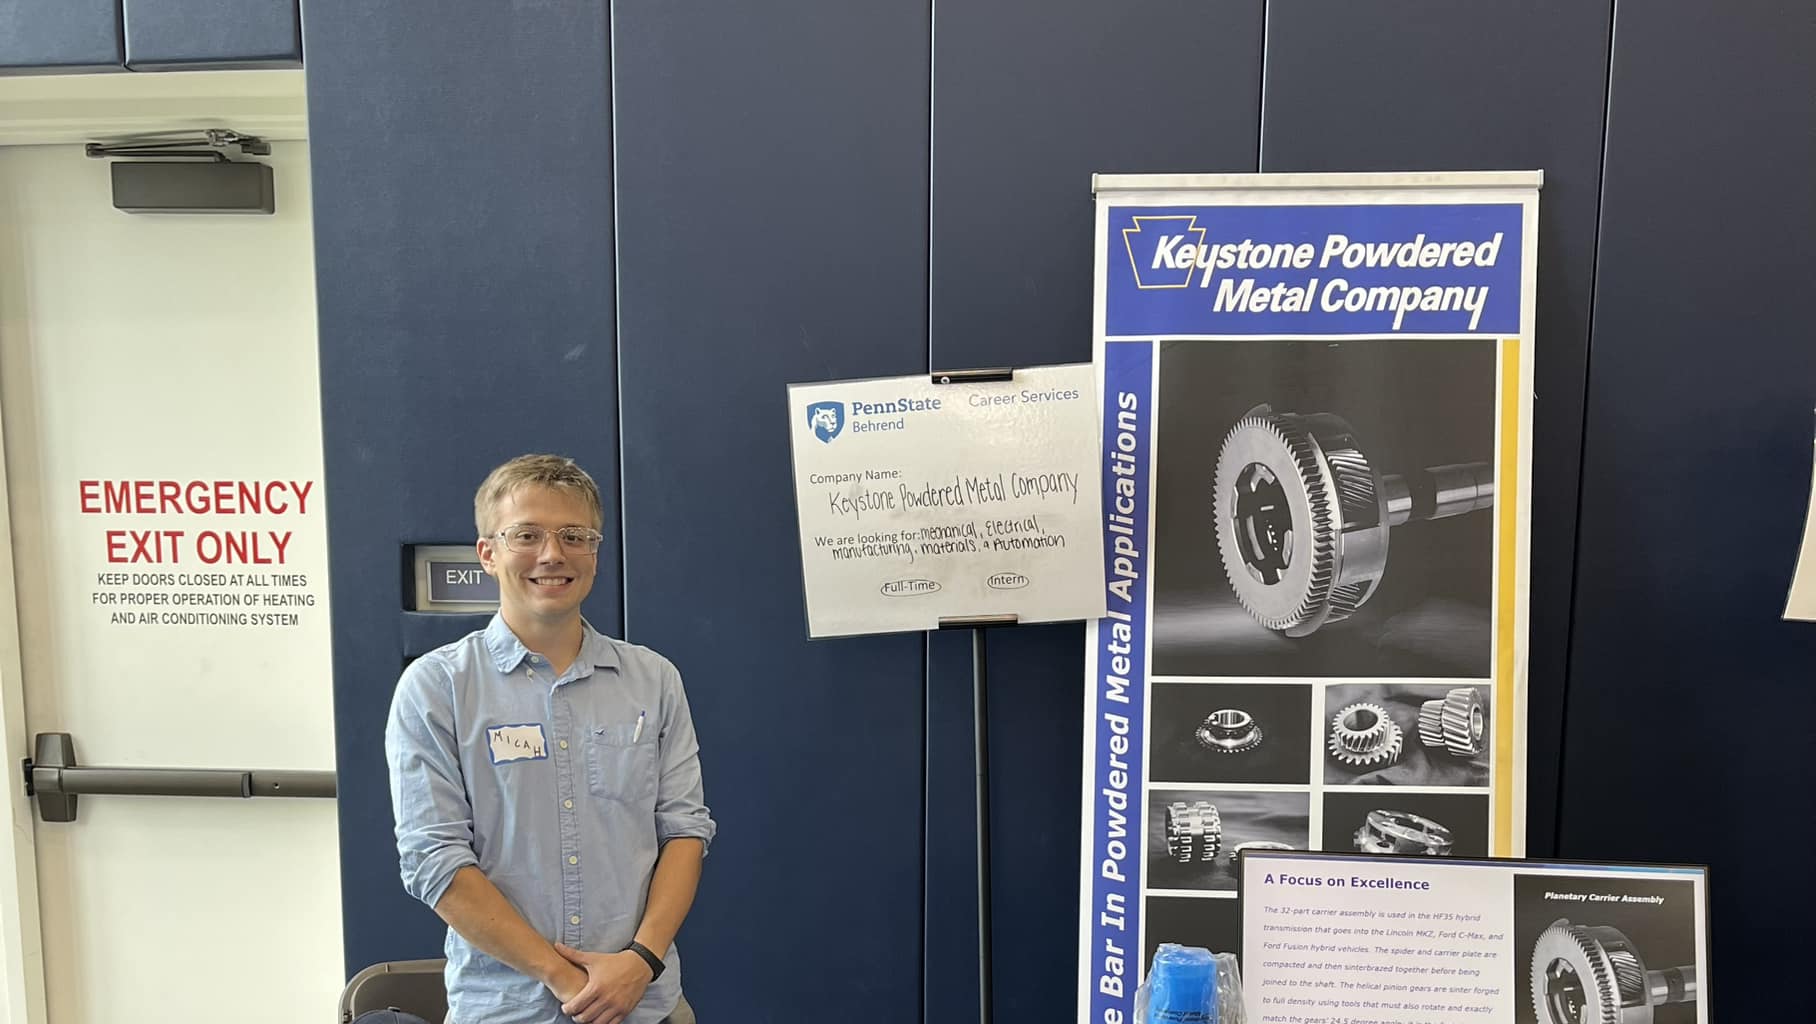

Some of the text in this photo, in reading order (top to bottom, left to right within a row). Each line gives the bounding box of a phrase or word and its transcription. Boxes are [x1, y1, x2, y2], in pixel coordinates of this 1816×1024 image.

[1151, 233, 1504, 288] Keystone Powdered
[1212, 278, 1489, 331] Metal Company
[851, 397, 942, 416] PennState
[968, 388, 1080, 408] Career Services
[852, 418, 905, 433] Behrend
[809, 469, 903, 485] Company Name:
[80, 480, 314, 515] EMERGENCY
[829, 471, 1079, 520] Keystone Powdered Metal Company
[1107, 391, 1139, 603] Applications
[106, 530, 292, 564] EXIT ONLY
[814, 530, 921, 547] We are looking for:
[98, 573, 307, 587] KEEP DOORS CLOSED AT ALL TIMES
[446, 569, 484, 585] EXIT
[884, 575, 1025, 593] Full-Time Intern
[92, 592, 315, 607] FOR PROPER OPERATION OF HEATING
[111, 612, 299, 626] AND AIR CONDITIONING SYSTEM
[1104, 610, 1132, 704] Metal
[493, 731, 542, 758] MICAH
[1100, 711, 1130, 883] Powdered
[1264, 873, 1430, 890] A Focus on Excellence
[1544, 891, 1664, 905] Planetary Carrier Assembly
[1101, 892, 1126, 932] In
[1264, 906, 1278, 914] The
[1339, 910, 1376, 919] assembly
[1387, 911, 1406, 919] used
[1455, 914, 1481, 923] hybrid
[1263, 925, 1312, 933] transmission
[1315, 926, 1331, 934] that
[1333, 928, 1351, 936] goes
[1354, 928, 1369, 936] into
[1371, 928, 1384, 936] the
[1386, 929, 1413, 937] Lincoln
[1438, 931, 1456, 939] Ford
[1489, 933, 1504, 941] and
[1263, 942, 1281, 950] Ford
[1283, 943, 1308, 951] Fusion
[1310, 944, 1335, 953] hybrid
[1375, 946, 1388, 954] The
[1391, 948, 1415, 957] spider
[1462, 950, 1482, 959] plate
[1100, 939, 1126, 1000] Bar
[1263, 961, 1306, 969] compacted
[1395, 966, 1428, 975] together
[1431, 967, 1456, 975] before
[1458, 968, 1480, 977] being
[1262, 979, 1286, 987] joined
[1340, 981, 1354, 989] The
[1356, 982, 1381, 990] helical
[1383, 984, 1407, 992] pinion
[1409, 986, 1431, 994] gears
[1449, 986, 1471, 994] sinter
[1473, 987, 1499, 996] forged
[1273, 996, 1285, 1004] full
[1288, 998, 1315, 1007] density
[1318, 1000, 1339, 1008] using
[1341, 1000, 1360, 1008] tools
[1363, 1001, 1379, 1009] that
[1403, 1002, 1419, 1010] also
[1464, 1005, 1493, 1014] exactly
